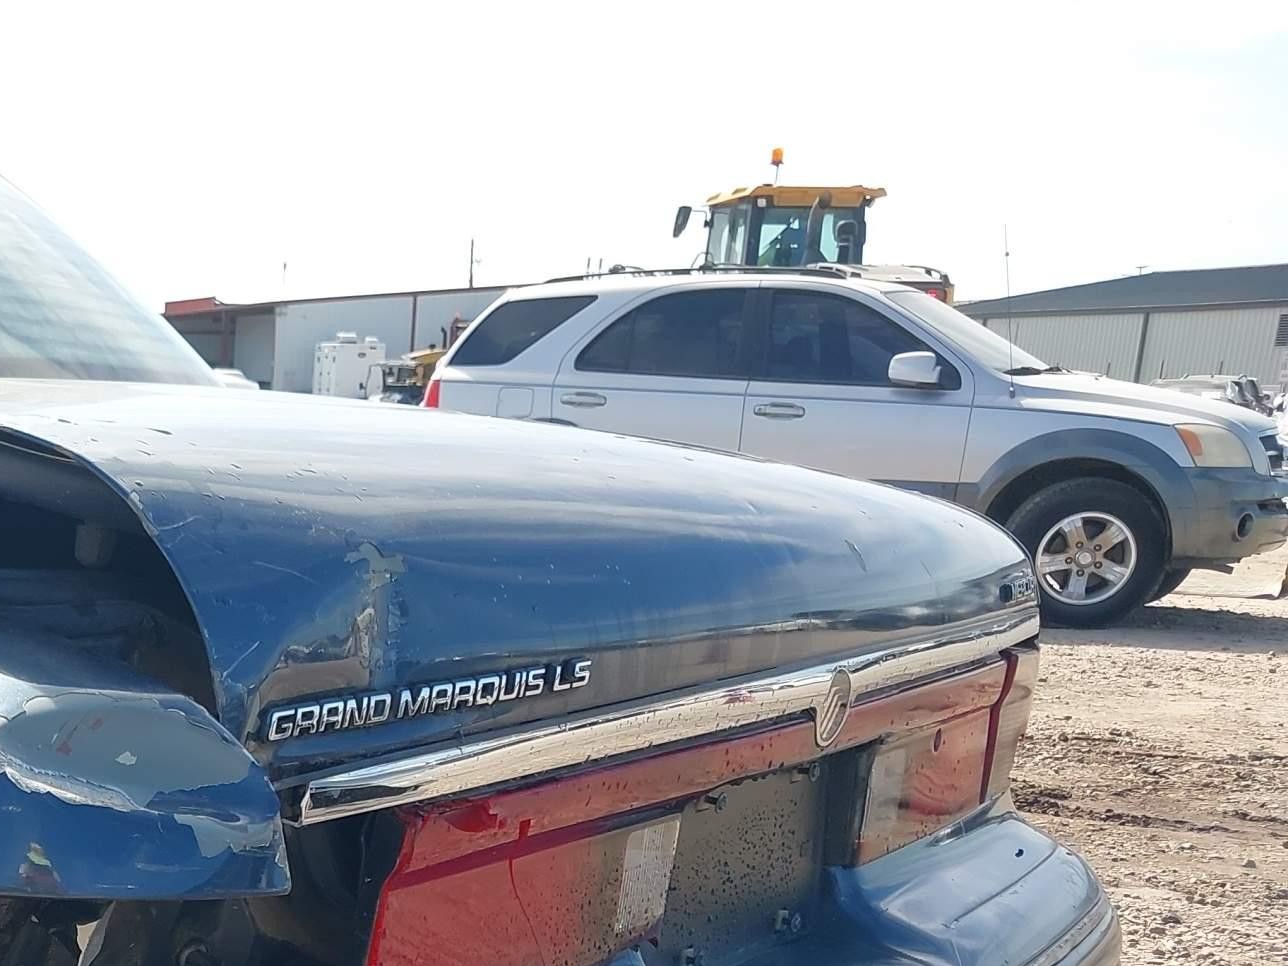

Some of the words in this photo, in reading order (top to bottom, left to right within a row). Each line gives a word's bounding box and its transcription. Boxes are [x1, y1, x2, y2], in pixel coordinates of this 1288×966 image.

[268, 693, 392, 741] GRAND
[397, 668, 546, 718] MARQUIS
[553, 660, 592, 692] LS
